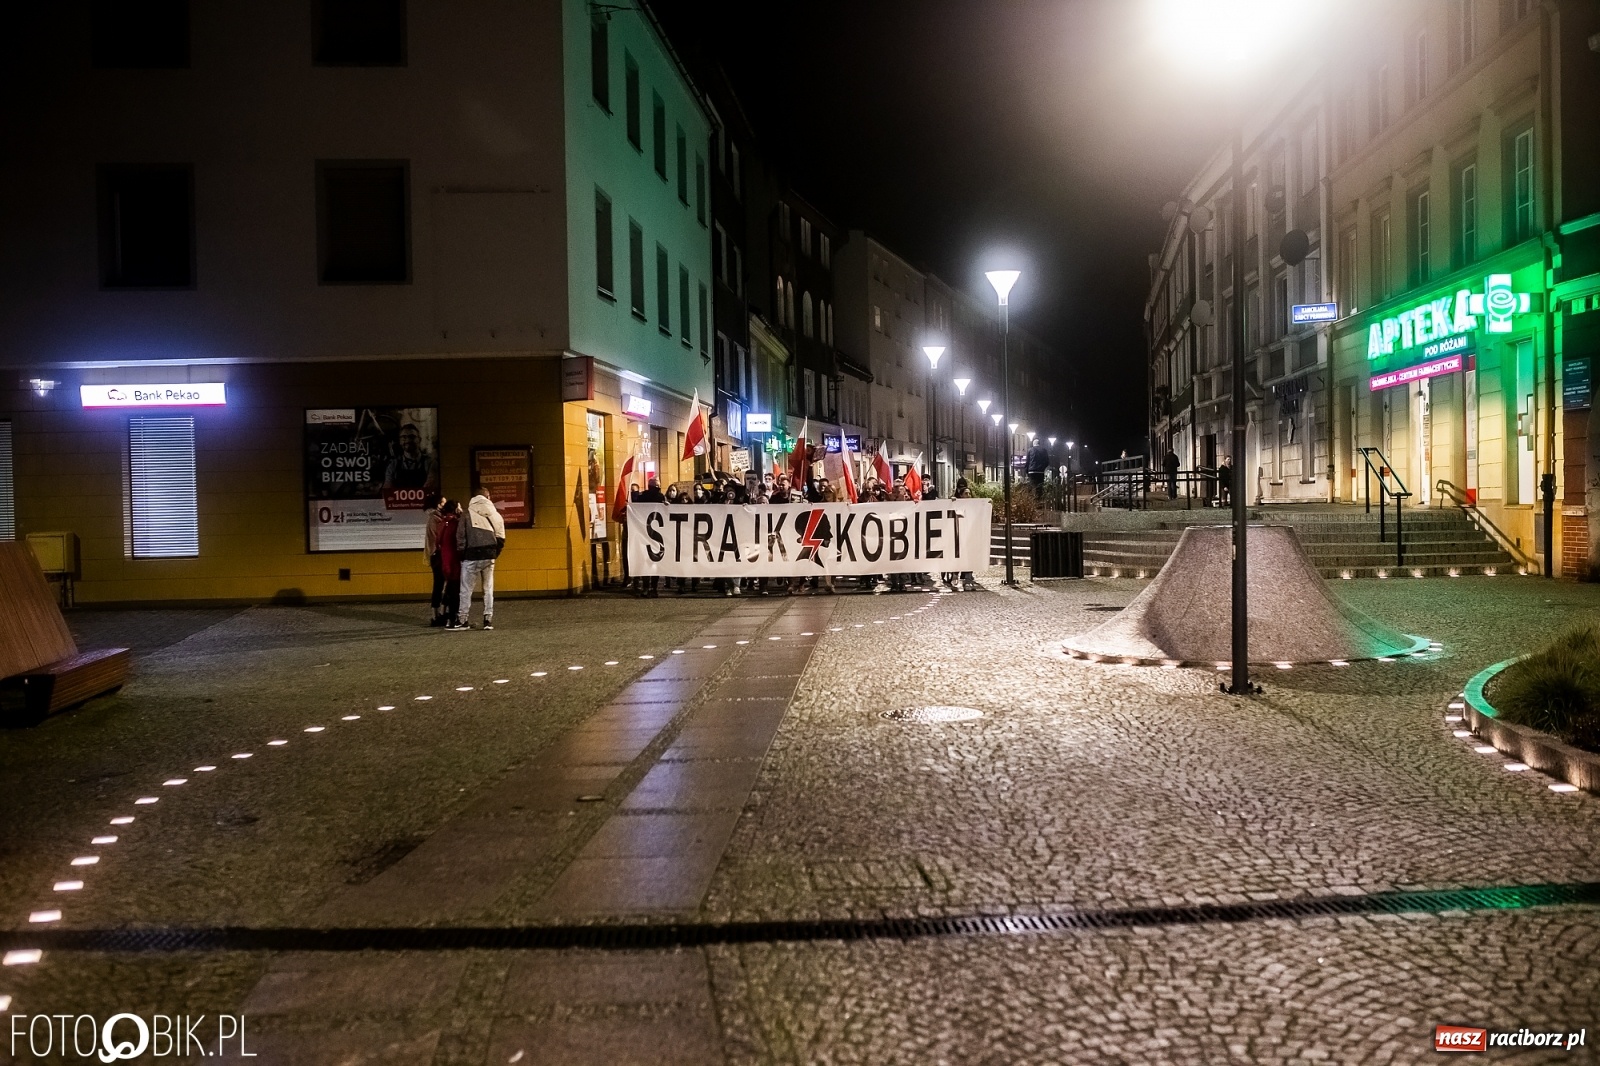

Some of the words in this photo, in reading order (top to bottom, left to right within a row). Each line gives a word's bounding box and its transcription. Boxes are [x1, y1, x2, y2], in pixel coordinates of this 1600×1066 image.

[1367, 289, 1478, 360] APTEKA
[1424, 344, 1438, 358] POD
[1439, 336, 1467, 354] RÓŻAMI
[134, 389, 163, 401] Bank
[166, 389, 200, 401] Pekao
[320, 442, 370, 455] ZADBAJ
[321, 457, 333, 468] O
[336, 454, 371, 470] SWÓJ
[322, 470, 371, 483] BIZNES
[394, 489, 424, 501] 1000
[318, 506, 331, 523] 0
[333, 511, 345, 523] zł
[646, 511, 789, 563] STRAJK
[835, 509, 965, 563] KOBIET
